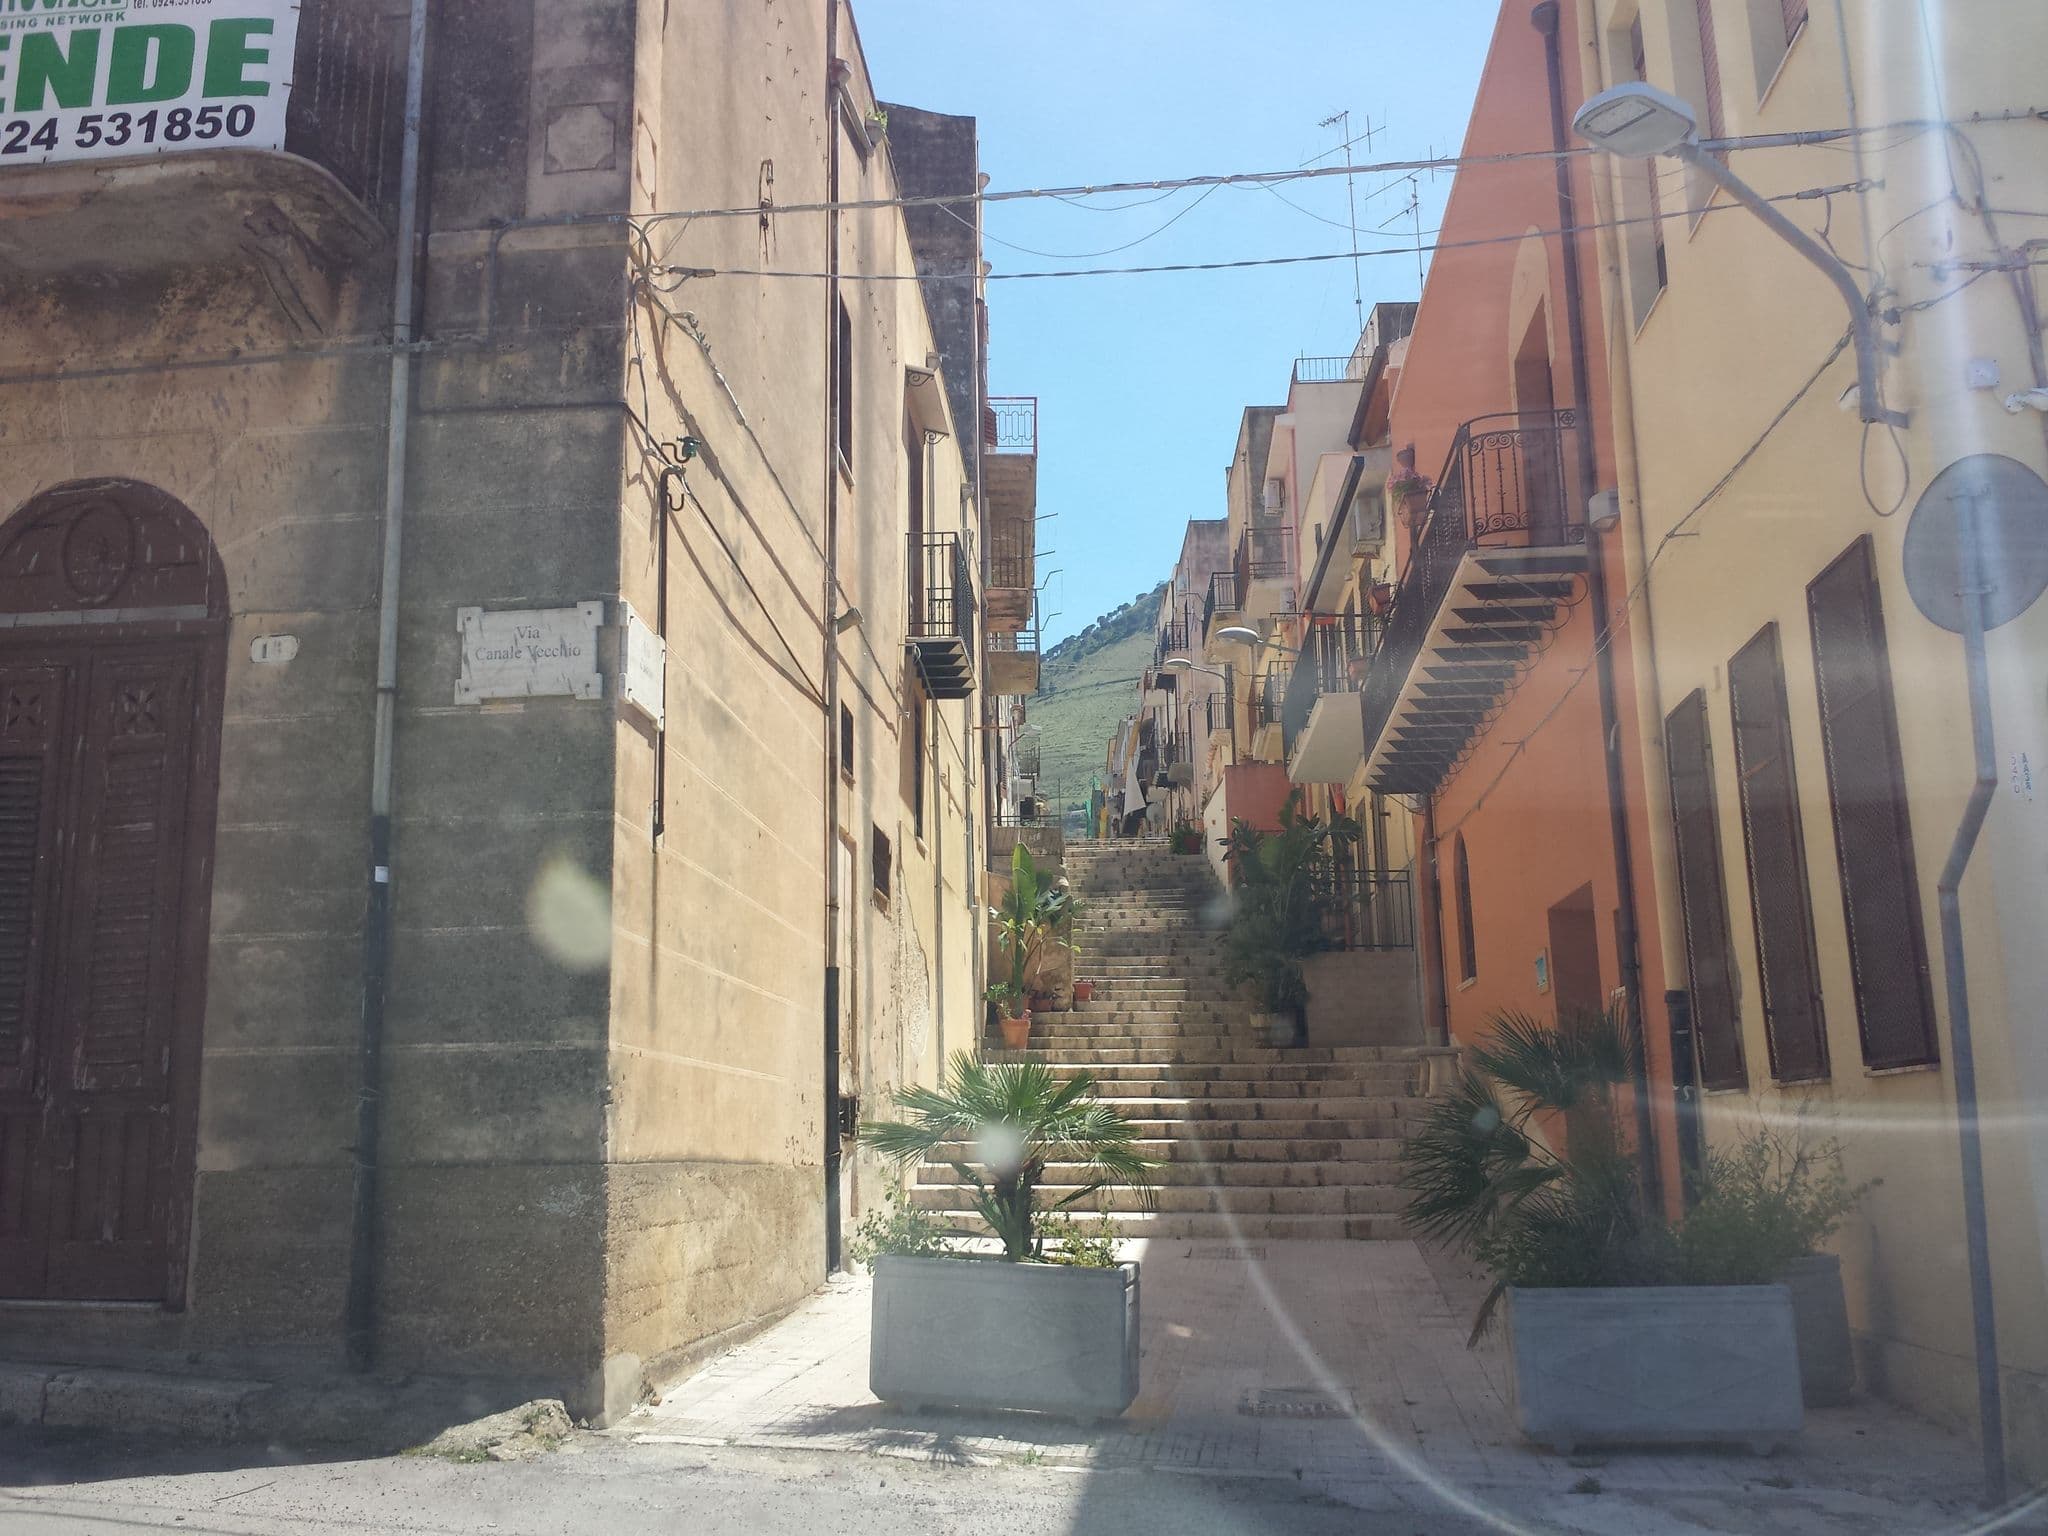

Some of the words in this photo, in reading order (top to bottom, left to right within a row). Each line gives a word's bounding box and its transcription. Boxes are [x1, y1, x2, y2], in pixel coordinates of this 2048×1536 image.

[45, 11, 126, 26] NETWORK
[0, 18, 274, 114] NDE
[0, 117, 59, 154] 24
[75, 104, 256, 149] 531850
[516, 625, 541, 639] Via
[475, 646, 522, 660] Canale
[526, 642, 581, 659] Vecchio
